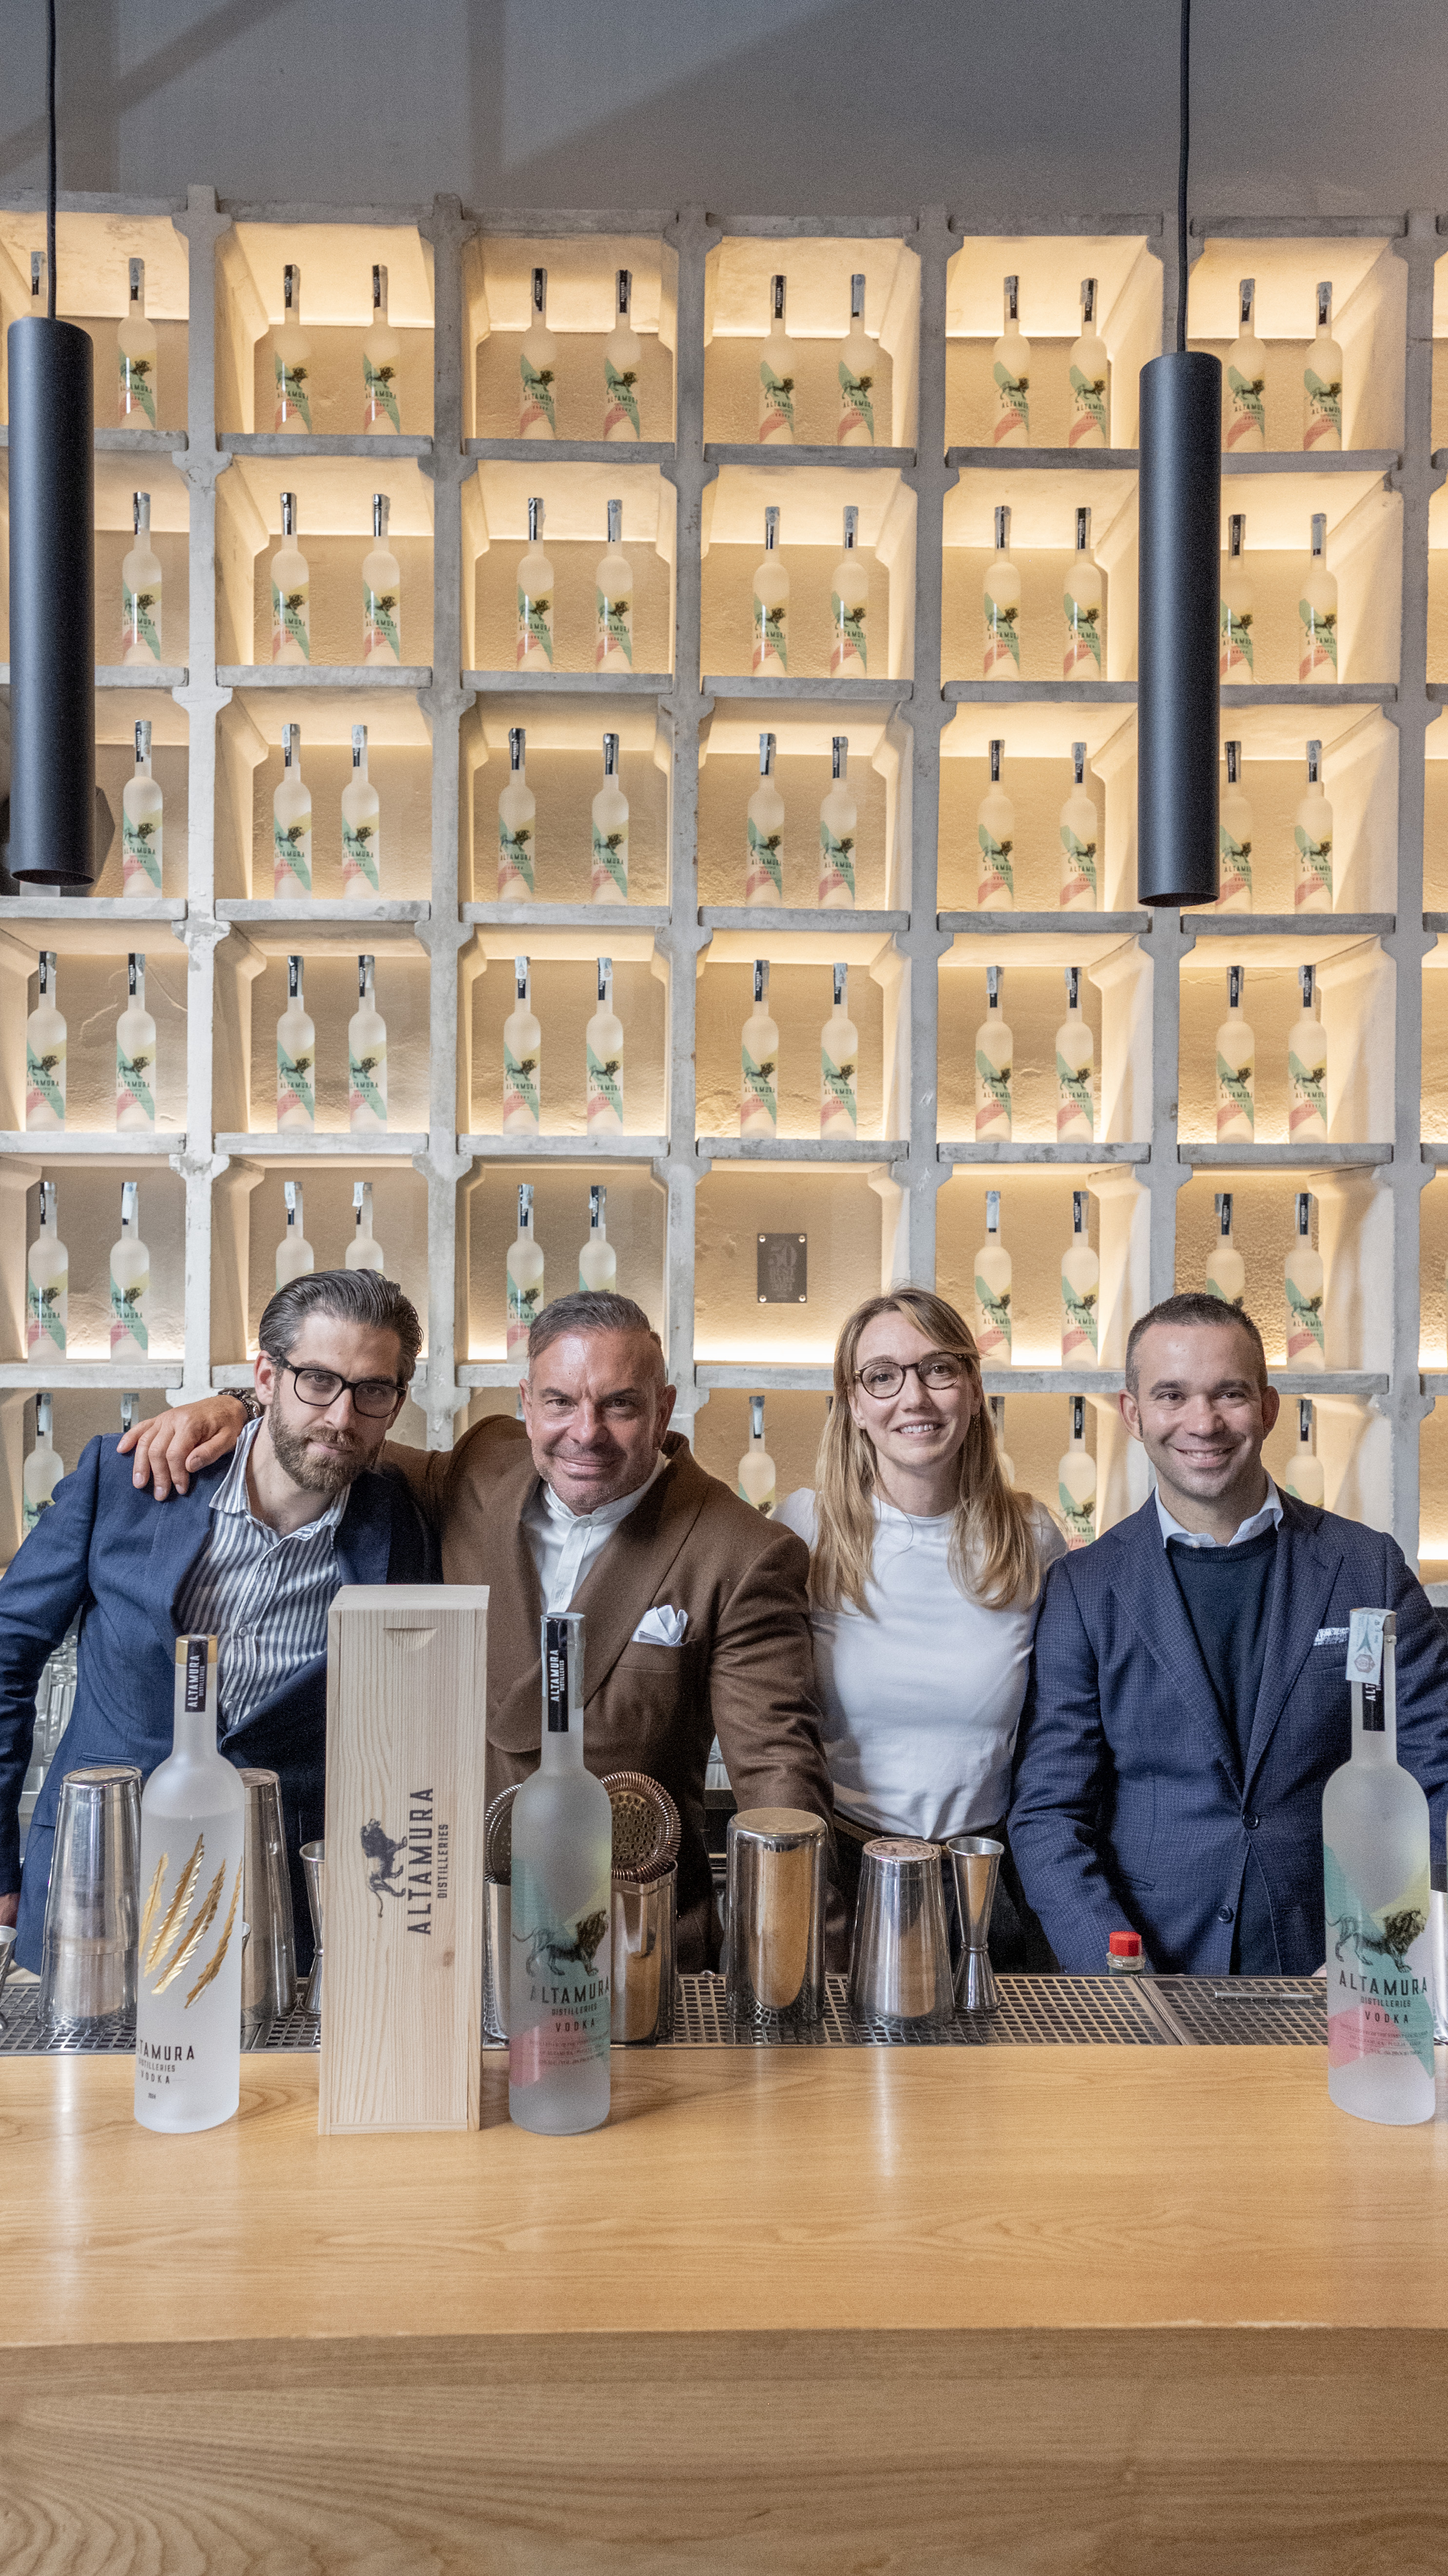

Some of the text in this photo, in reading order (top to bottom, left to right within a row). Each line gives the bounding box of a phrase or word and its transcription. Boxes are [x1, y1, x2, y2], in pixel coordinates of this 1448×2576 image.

[187, 1655, 200, 1708] ALTAMURA
[549, 1650, 560, 1702] ALTAMURA
[407, 1788, 433, 1935] ALTAMURA
[438, 1824, 448, 1898] DISTILLERIES
[530, 1976, 609, 2004] ALTAMURA
[1339, 1970, 1427, 1996] ALTAMURA
[552, 2003, 598, 2016] DISTILLERIES
[1360, 1996, 1411, 2007] DISTILLERIES
[556, 2019, 595, 2032] VODKA
[1365, 2011, 1409, 2023] VODKA
[137, 2039, 194, 2060] TAMURA
[140, 2070, 170, 2084] VODKA
